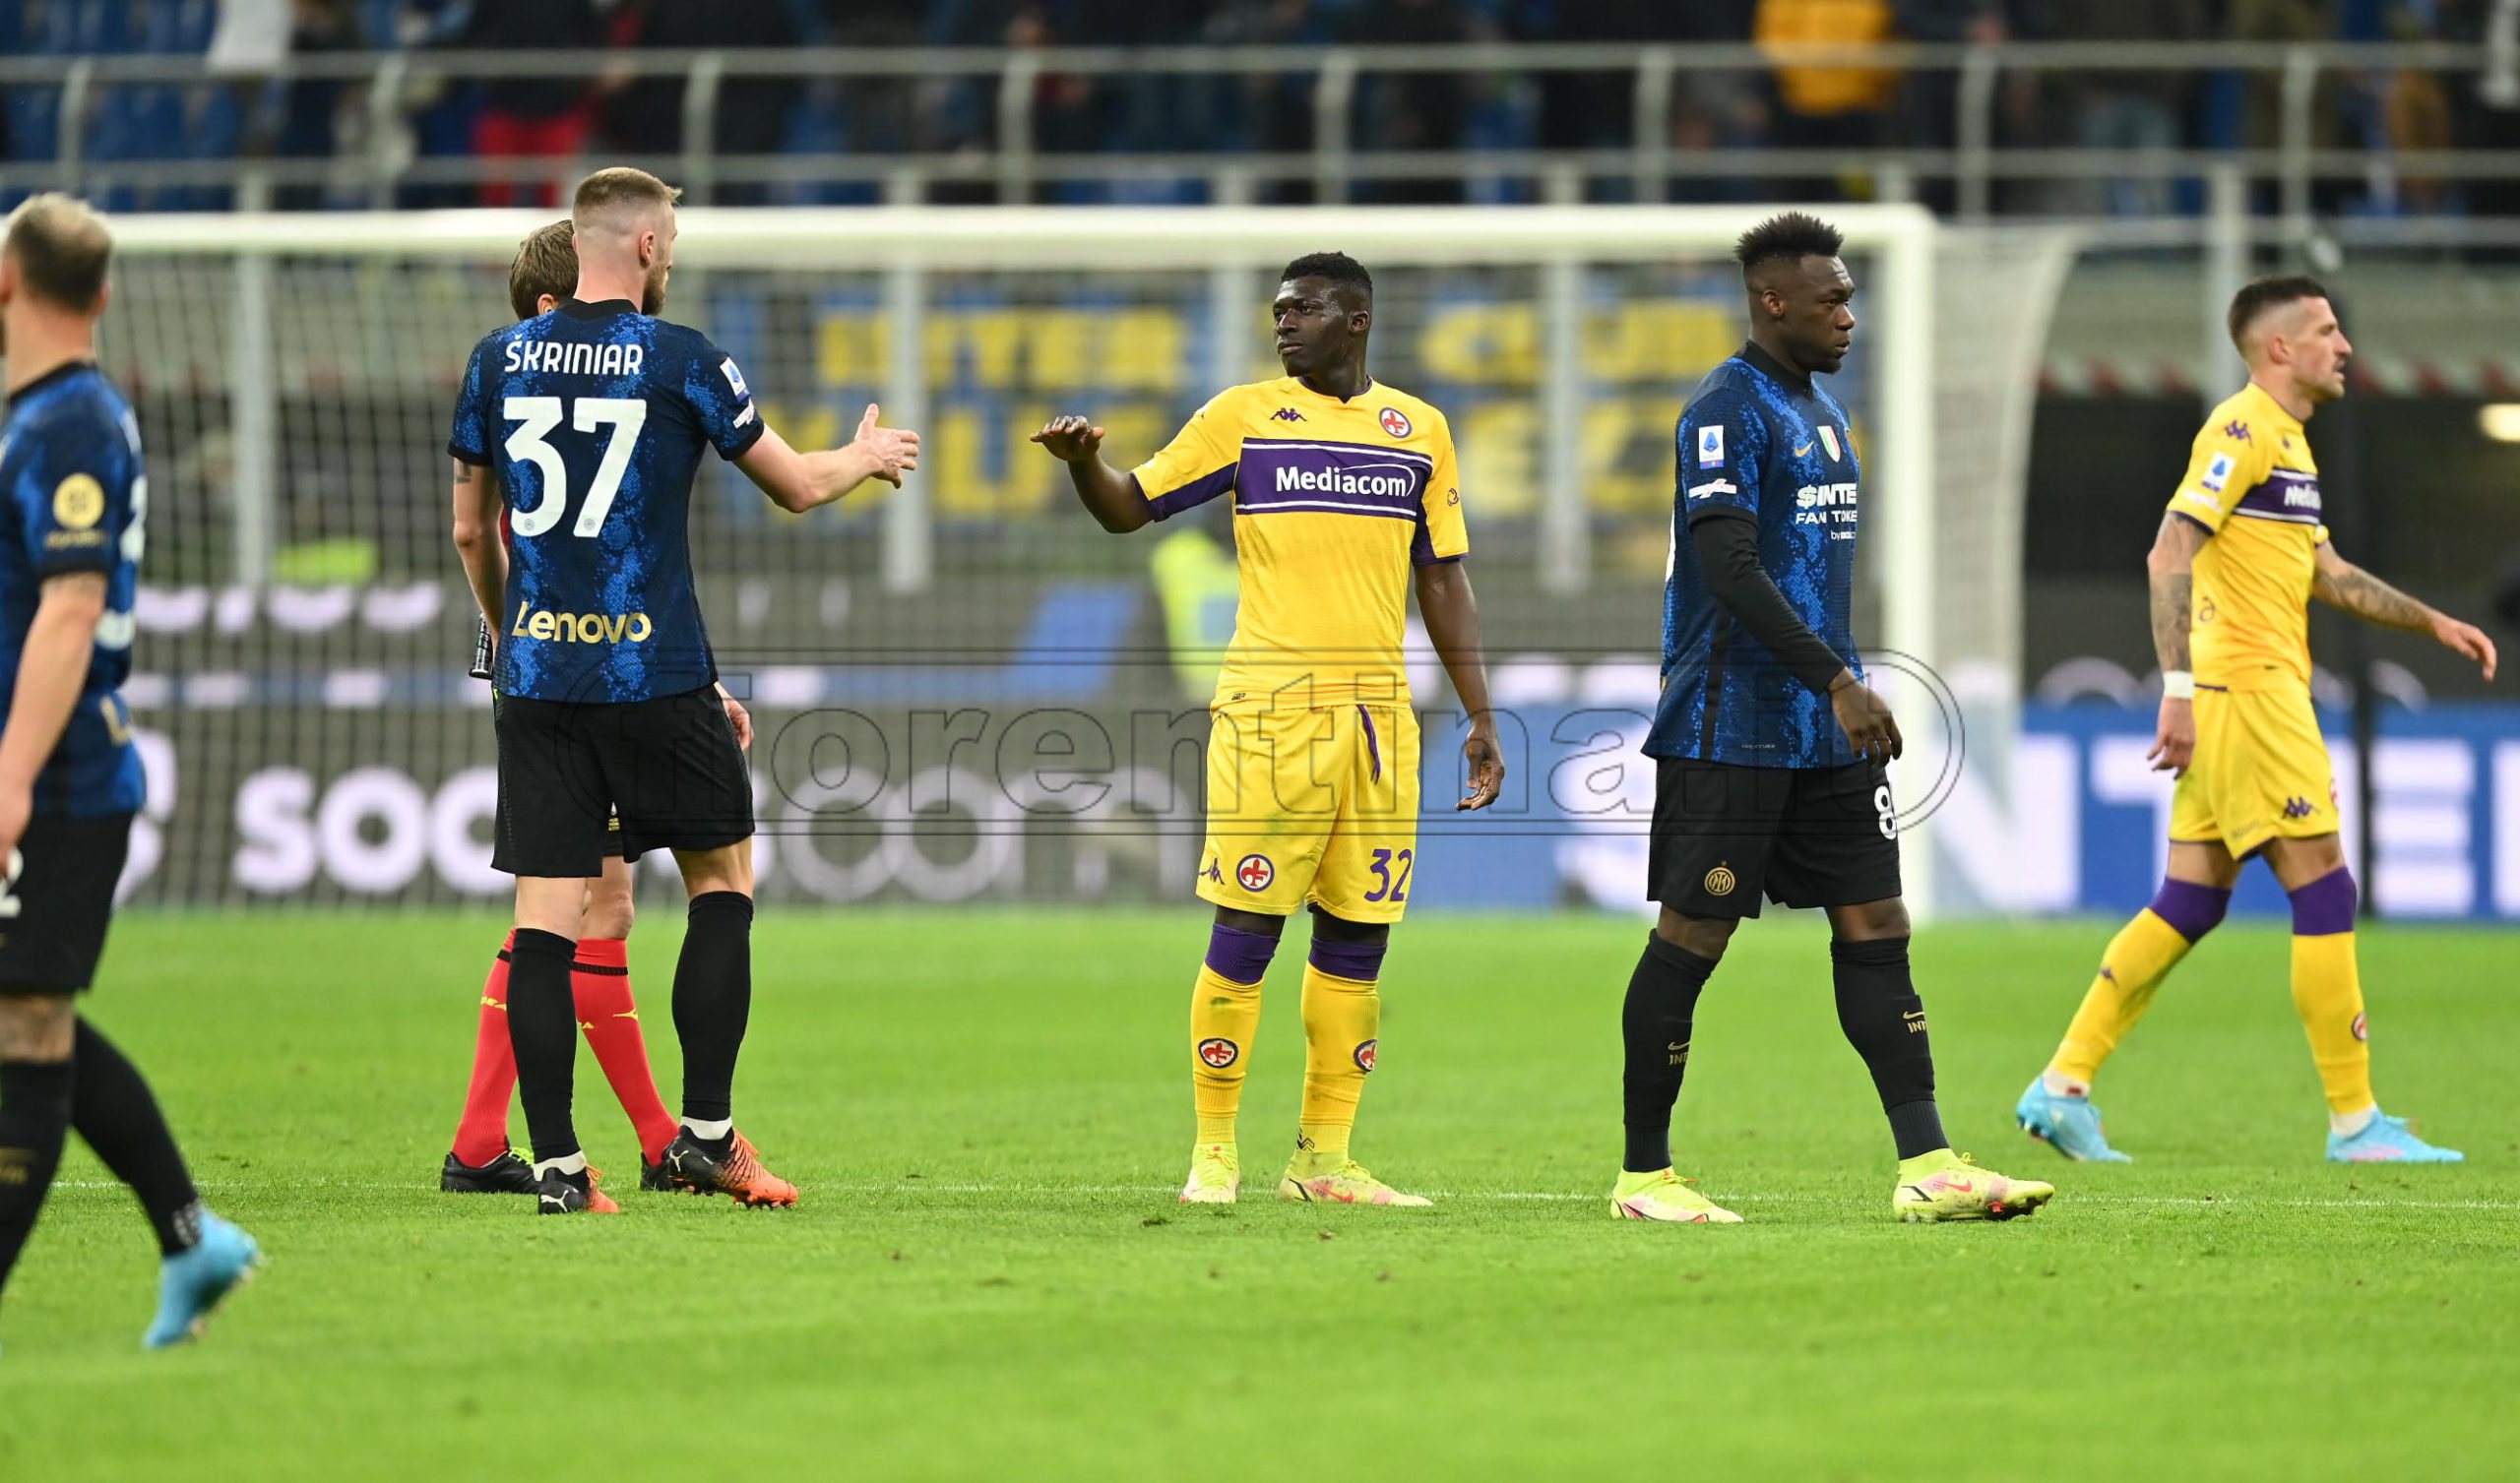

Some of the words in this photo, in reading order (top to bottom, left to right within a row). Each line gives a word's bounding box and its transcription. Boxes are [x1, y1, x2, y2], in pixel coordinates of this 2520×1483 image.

[505, 334, 643, 375] ŠKRINIAR
[503, 396, 647, 538] 37
[1276, 465, 1408, 497] Mediacom
[1796, 483, 1858, 510] $INTE
[1796, 512, 1827, 525] FAN
[1831, 510, 1858, 523] TOKE
[511, 601, 652, 644] Lenovo
[1874, 784, 1897, 840] 8
[1363, 848, 1413, 901] 32
